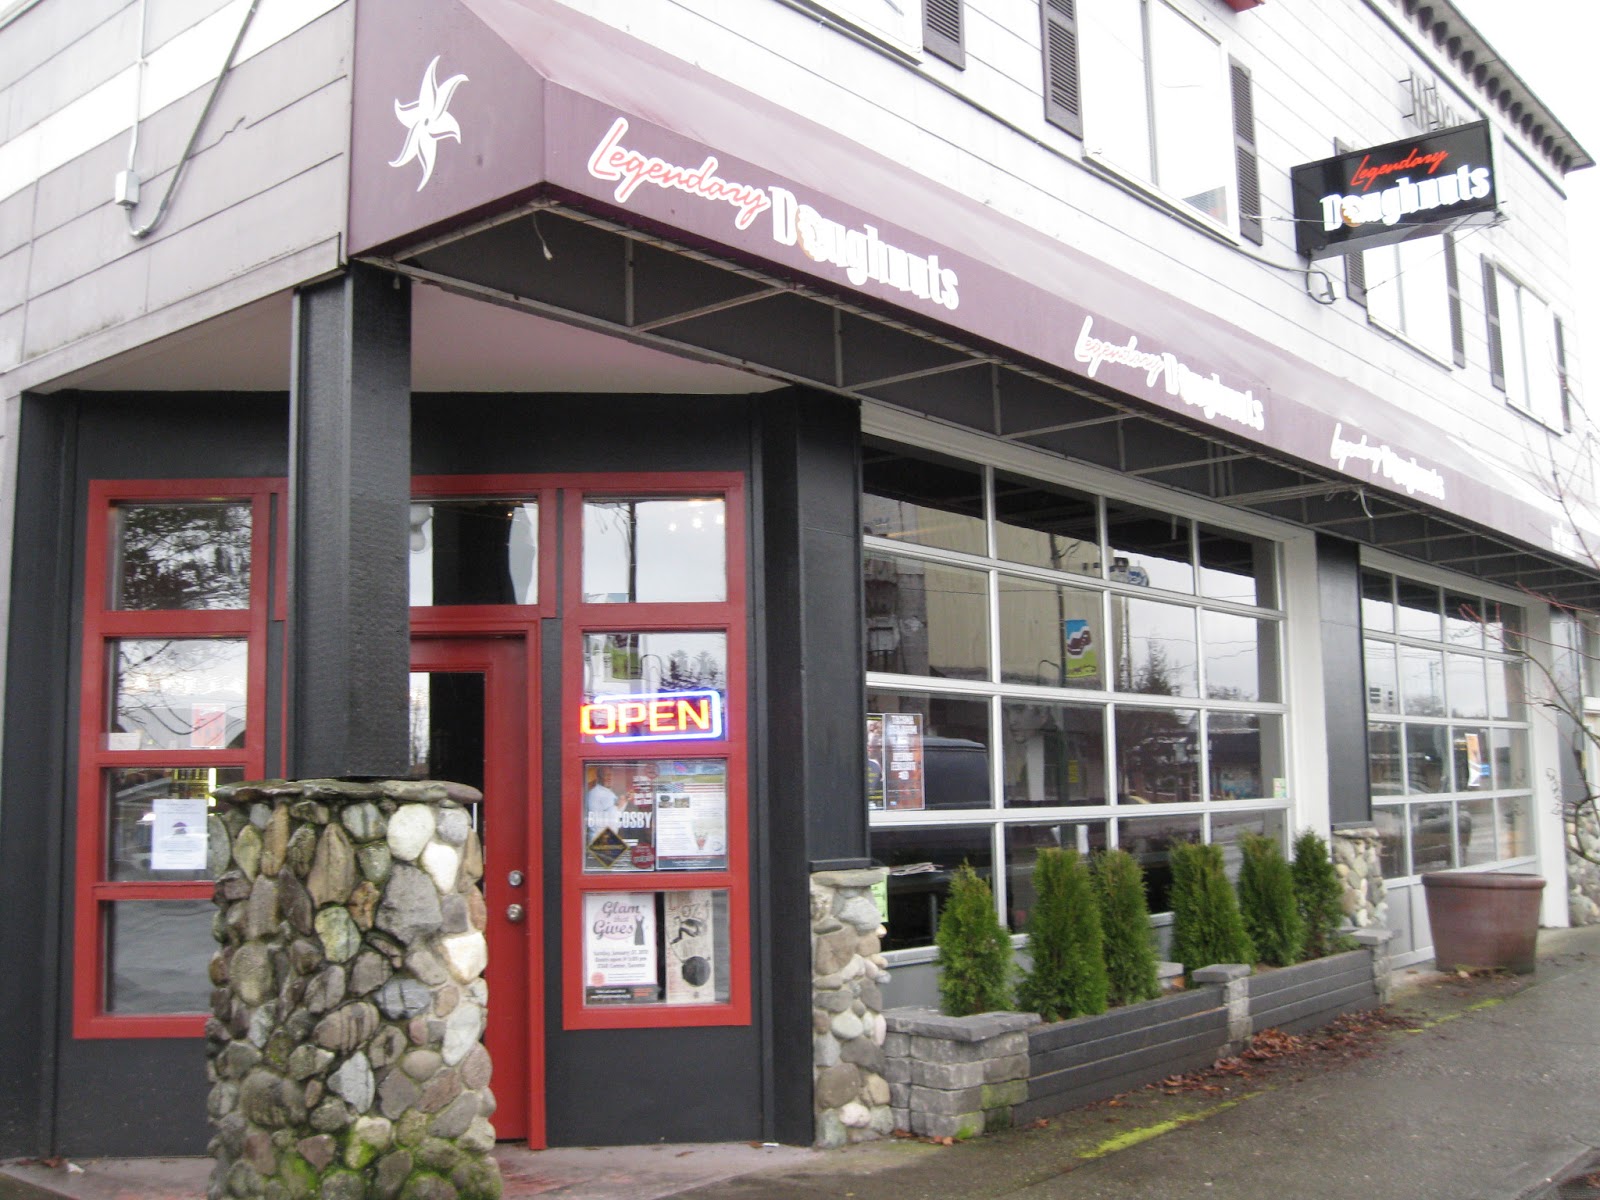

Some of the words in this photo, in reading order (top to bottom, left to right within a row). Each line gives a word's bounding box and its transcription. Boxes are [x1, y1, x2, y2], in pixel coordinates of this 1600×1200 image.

[1351, 148, 1449, 191] Legendary
[588, 117, 771, 230] Legendary
[768, 186, 960, 310] Doughnuts
[1319, 164, 1490, 231] Doughnuts
[580, 699, 710, 735] OPEN
[616, 811, 653, 829] COSBY
[602, 901, 641, 916] Glam
[593, 920, 634, 940] Gives
